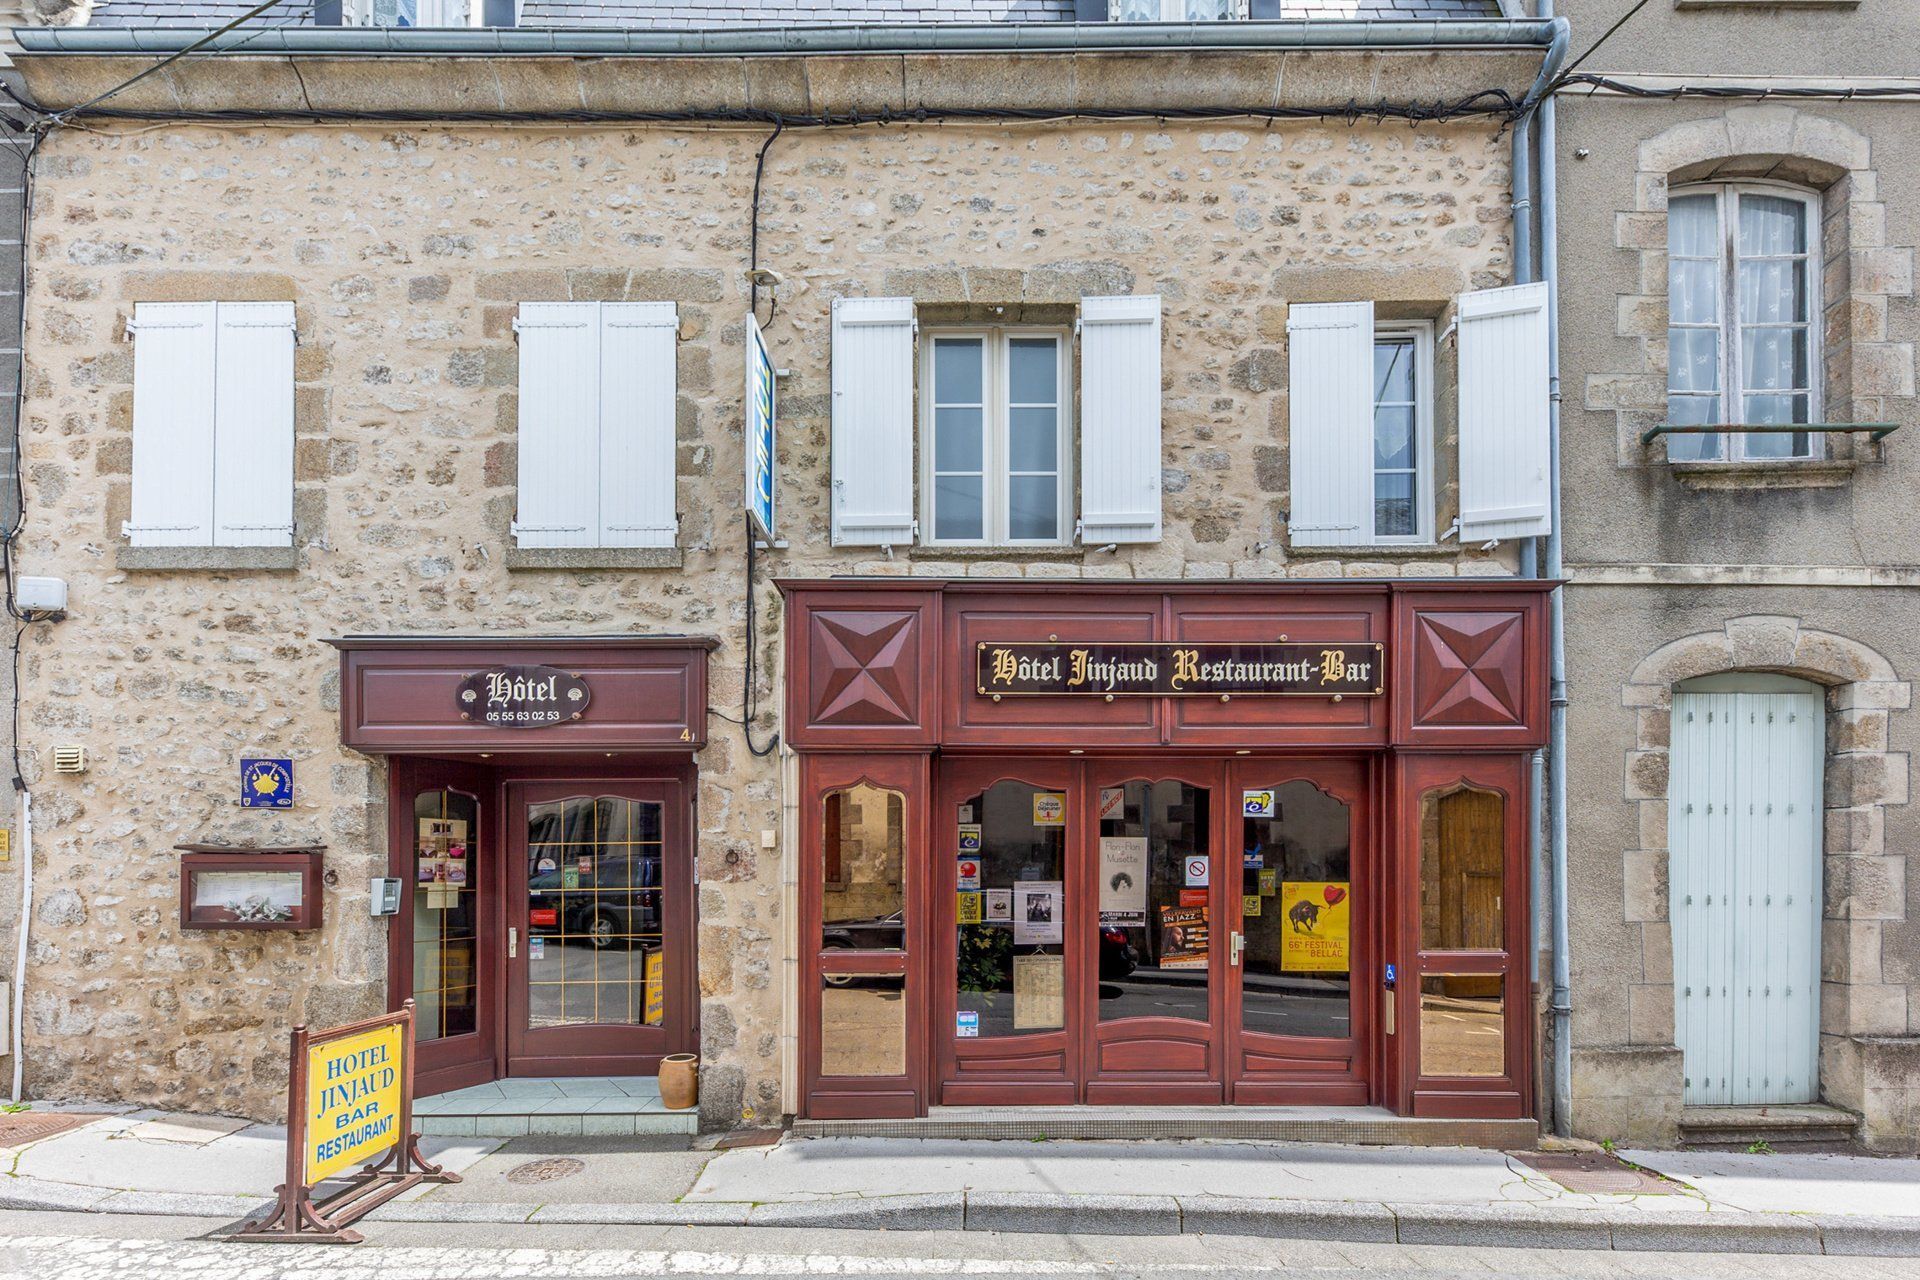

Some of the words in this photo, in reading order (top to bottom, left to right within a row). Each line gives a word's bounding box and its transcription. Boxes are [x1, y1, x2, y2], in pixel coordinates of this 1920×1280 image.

[991, 648, 1061, 686] Hôtel
[1067, 648, 1158, 691] Jinjaud
[1171, 648, 1372, 690] Restaurant-Bar
[485, 672, 558, 708] Hôtel
[486, 711, 499, 721] 05
[501, 711, 515, 721] 55
[517, 711, 529, 721] 63
[531, 711, 545, 721] 02
[547, 711, 560, 721] 53
[680, 728, 690, 742] 4
[1106, 854, 1138, 863] Musette
[1176, 913, 1196, 923] JAZZ
[1304, 941, 1343, 949] FESTIVAL
[1310, 949, 1343, 958] BELLAC
[327, 1044, 390, 1080] HOTEL
[317, 1067, 395, 1119] JINJAUD
[336, 1102, 379, 1129] BAR
[317, 1114, 394, 1163] RESTAURANT
